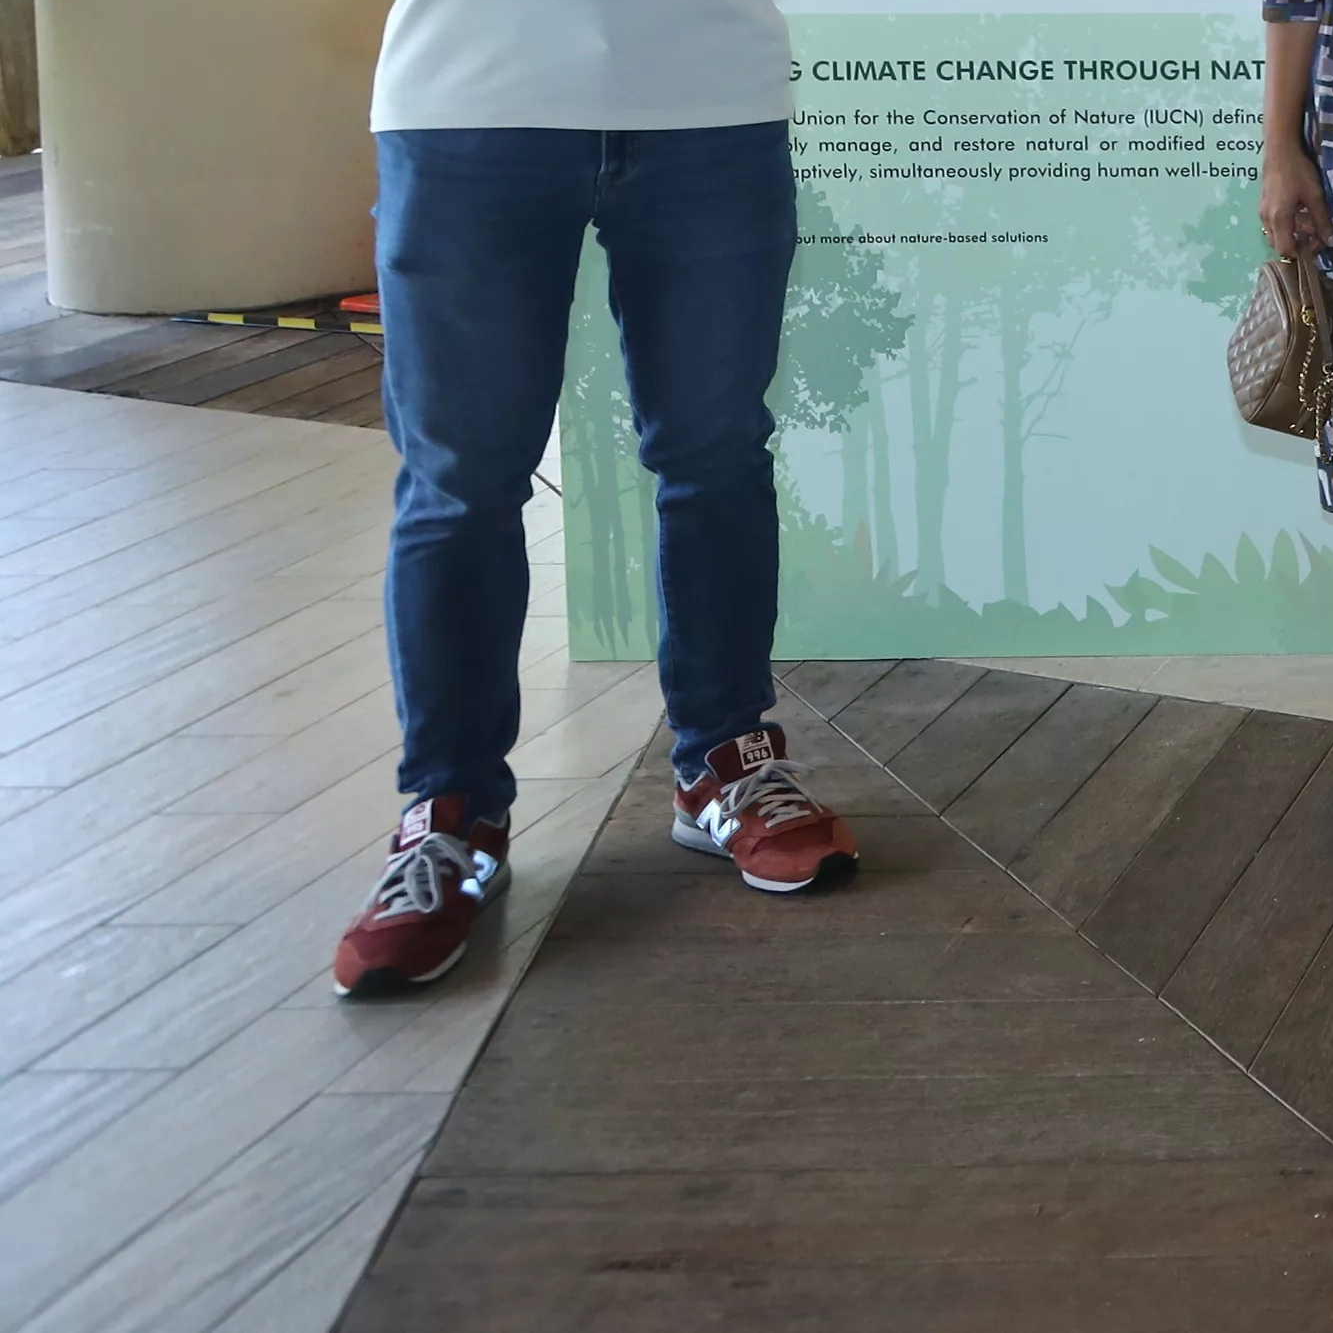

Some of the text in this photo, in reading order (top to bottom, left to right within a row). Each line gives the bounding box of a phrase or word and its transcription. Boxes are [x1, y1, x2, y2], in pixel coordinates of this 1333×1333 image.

[812, 59, 1200, 82] CLIMATE CHANGE THROUGH
[796, 231, 1049, 245] out more about nature-based solutions
[746, 748, 768, 763] 996
